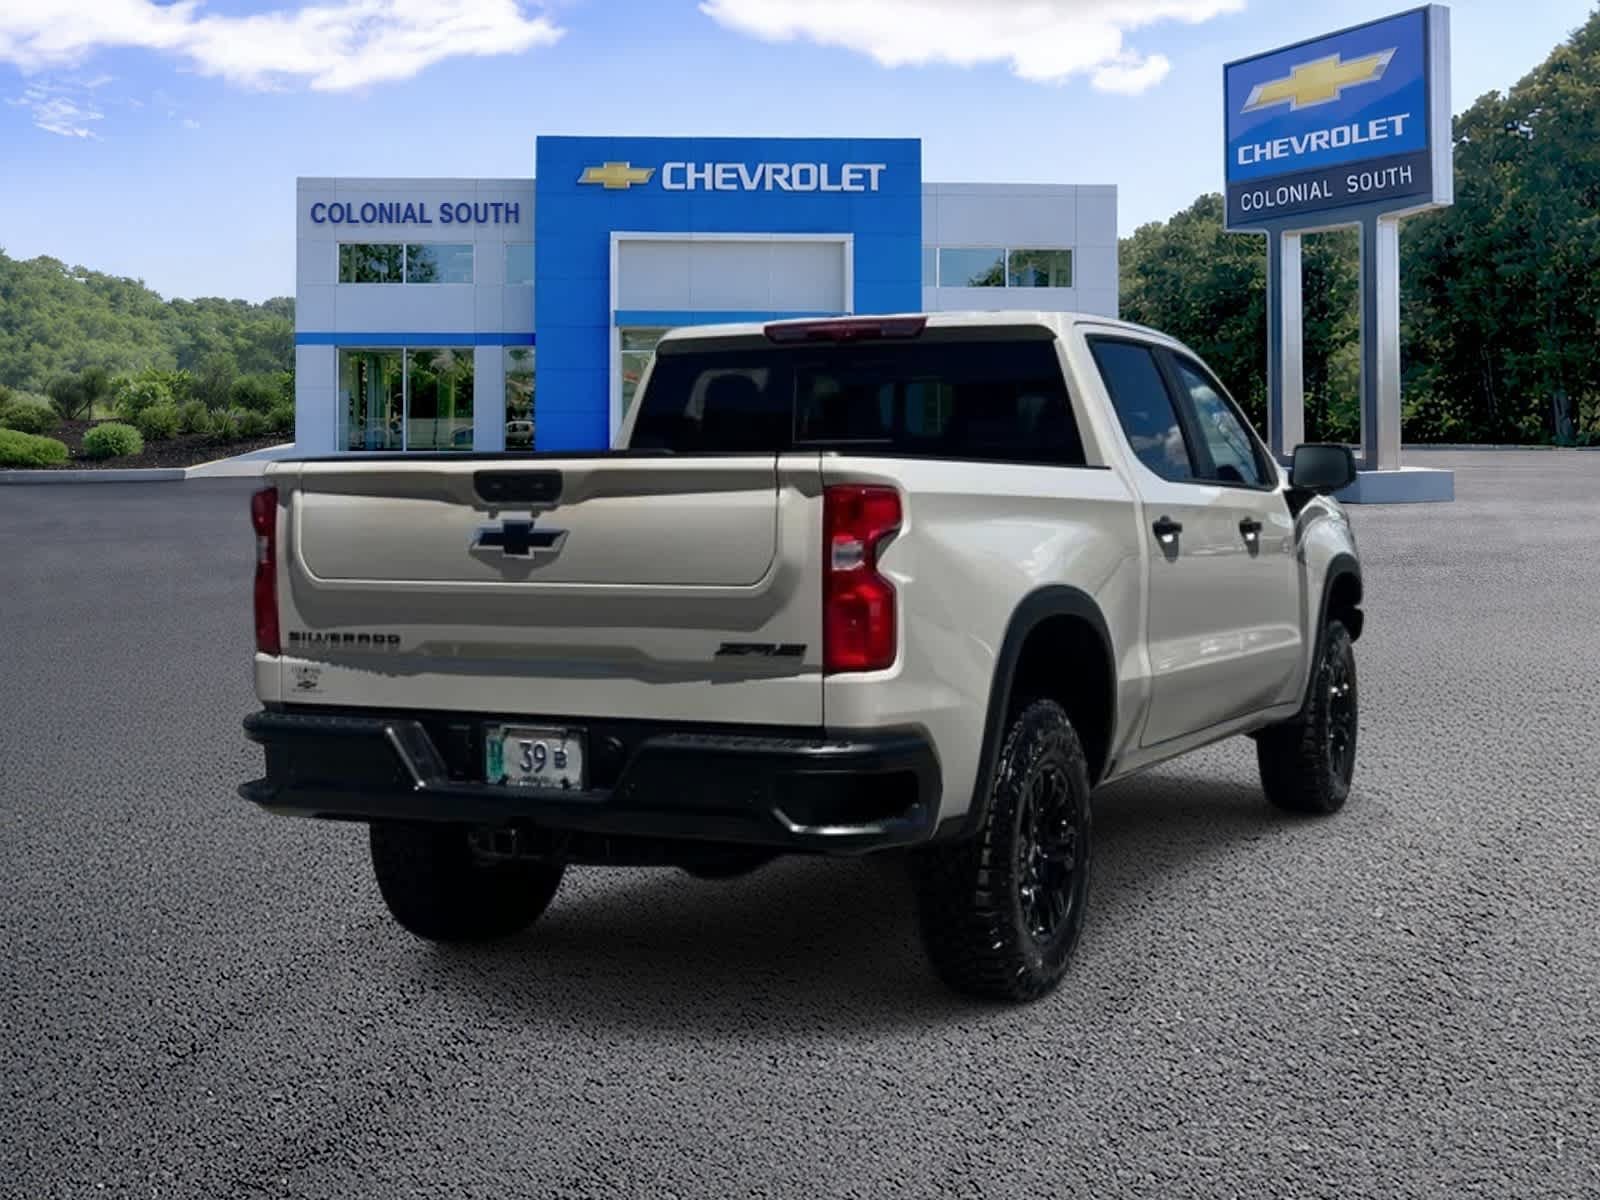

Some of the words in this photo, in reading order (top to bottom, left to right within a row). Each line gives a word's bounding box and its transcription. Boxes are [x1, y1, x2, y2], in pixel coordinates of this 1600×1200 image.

[1238, 113, 1410, 165] CHEVROLET
[662, 162, 886, 192] CHEVROLET
[1241, 180, 1333, 211] COLONIAL
[1346, 165, 1413, 193] SOUTH
[310, 202, 433, 225] COLONIAL
[439, 202, 521, 225] SOUTH
